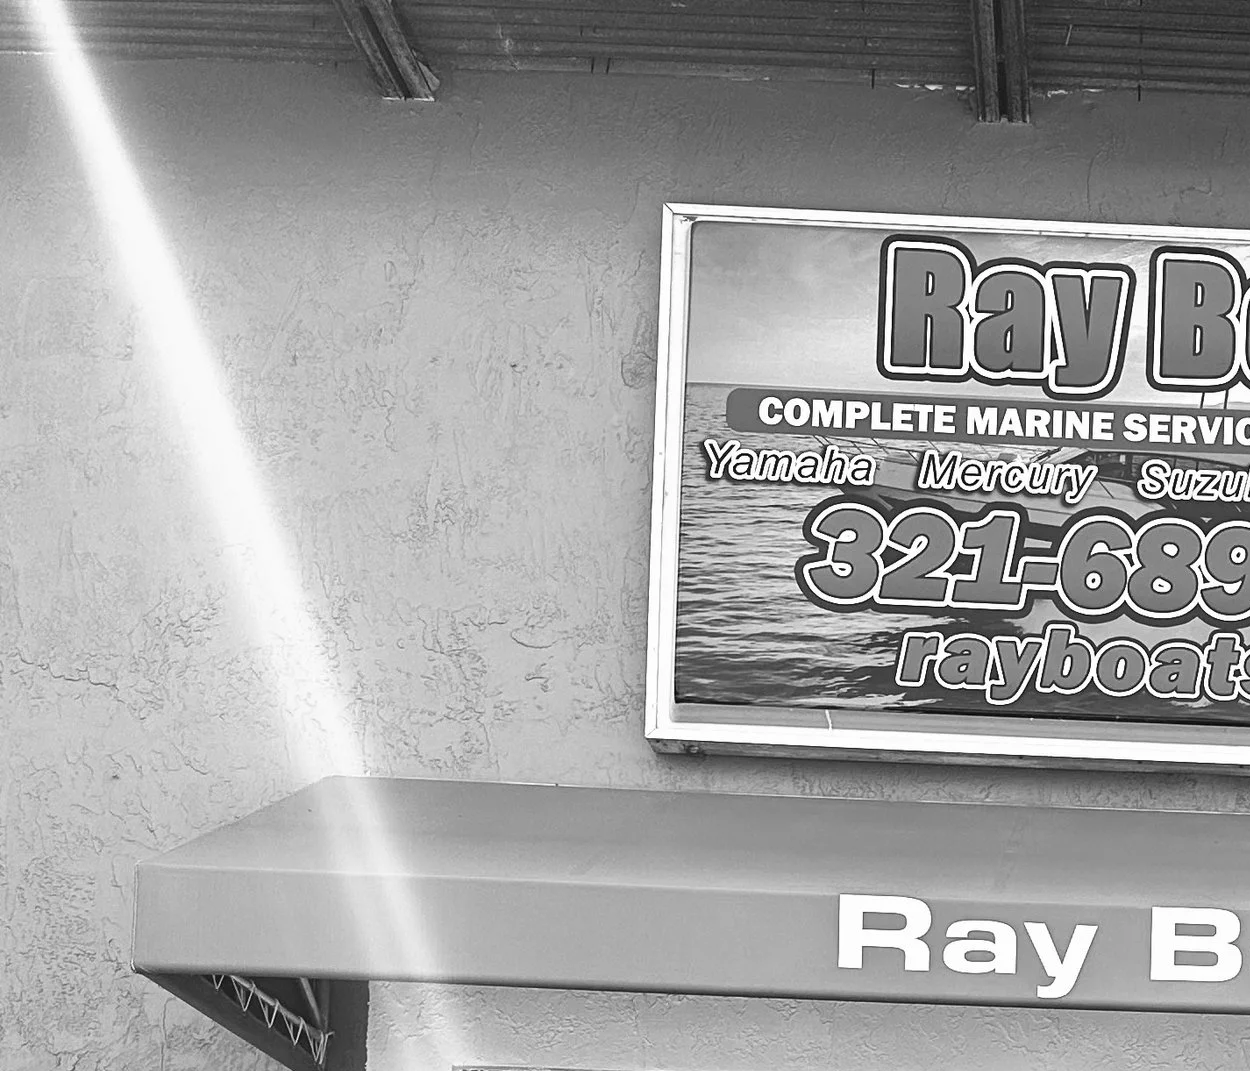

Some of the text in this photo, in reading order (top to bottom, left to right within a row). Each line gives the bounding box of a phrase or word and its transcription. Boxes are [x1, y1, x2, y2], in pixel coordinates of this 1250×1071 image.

[883, 238, 1133, 396] Ray
[758, 396, 957, 433] COMPLETE
[966, 406, 1115, 440] MARINE
[703, 439, 877, 486] Yamaha
[918, 449, 1099, 504] Mercury
[837, 893, 1098, 999] Ray
